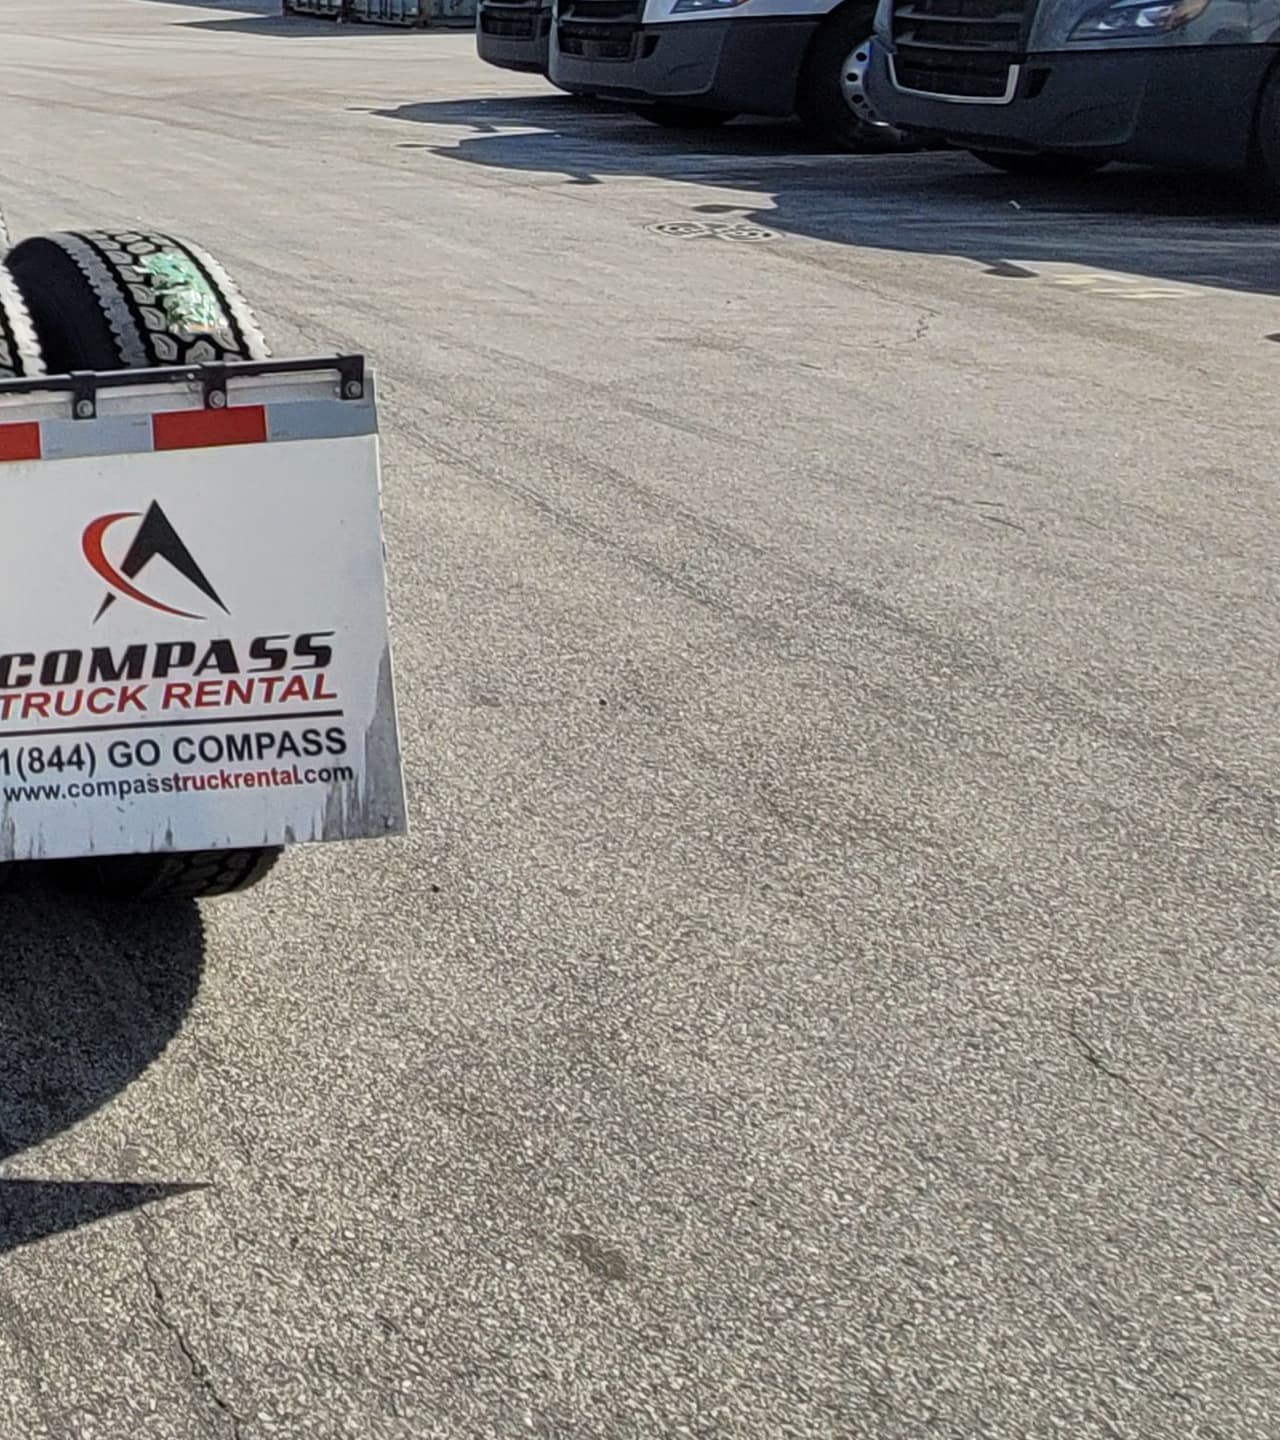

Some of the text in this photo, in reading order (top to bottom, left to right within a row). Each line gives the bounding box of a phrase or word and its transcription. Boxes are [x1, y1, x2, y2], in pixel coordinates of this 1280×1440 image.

[162, 673, 338, 710] RENTAL
[108, 739, 161, 768] GO
[173, 727, 347, 764] COMPASS
[3, 764, 354, 802] www.compasstruckrental.com
